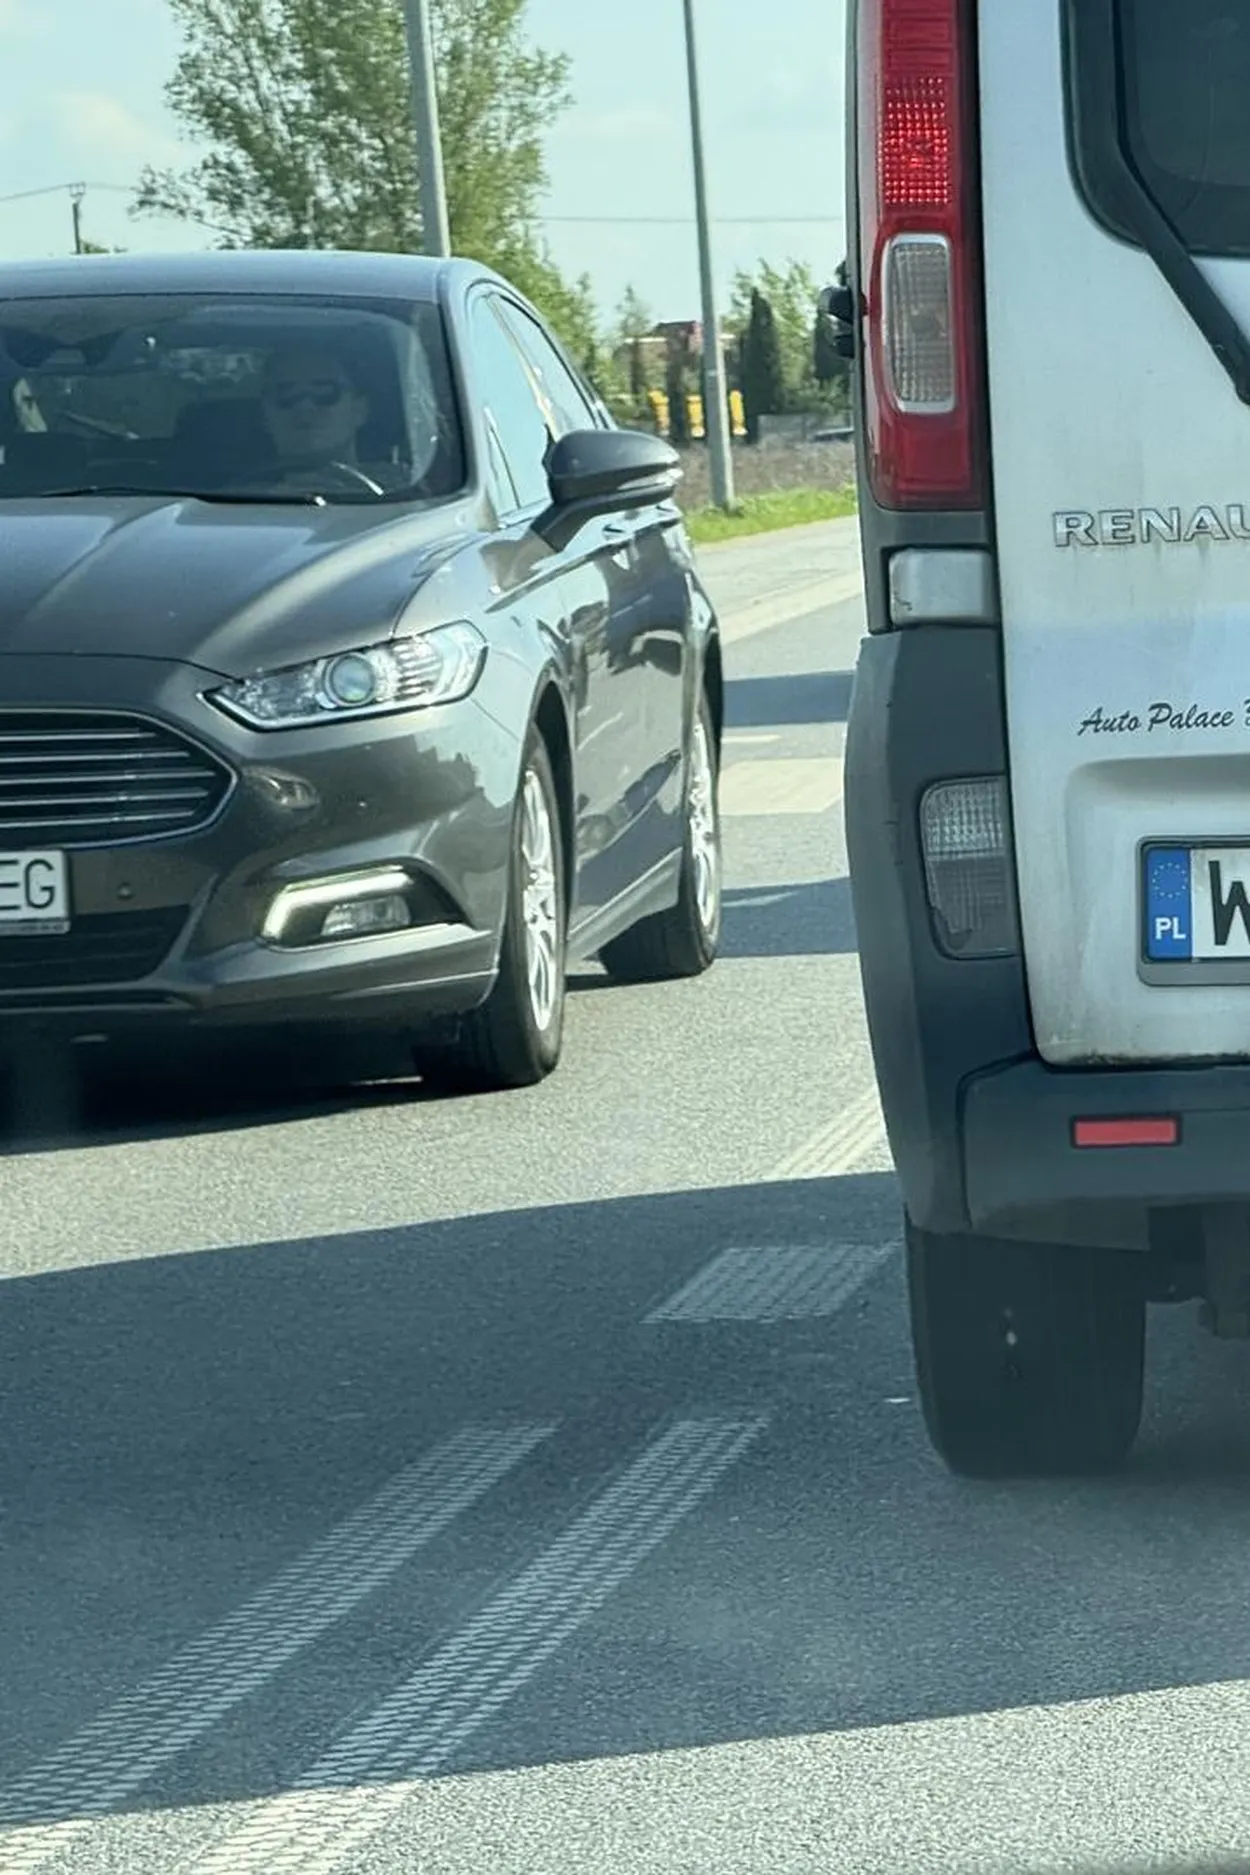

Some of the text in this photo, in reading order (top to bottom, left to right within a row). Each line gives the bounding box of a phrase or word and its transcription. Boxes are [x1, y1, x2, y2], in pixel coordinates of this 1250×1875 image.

[1077, 702, 1234, 736] Auto Palace
[1155, 917, 1187, 940] PL
